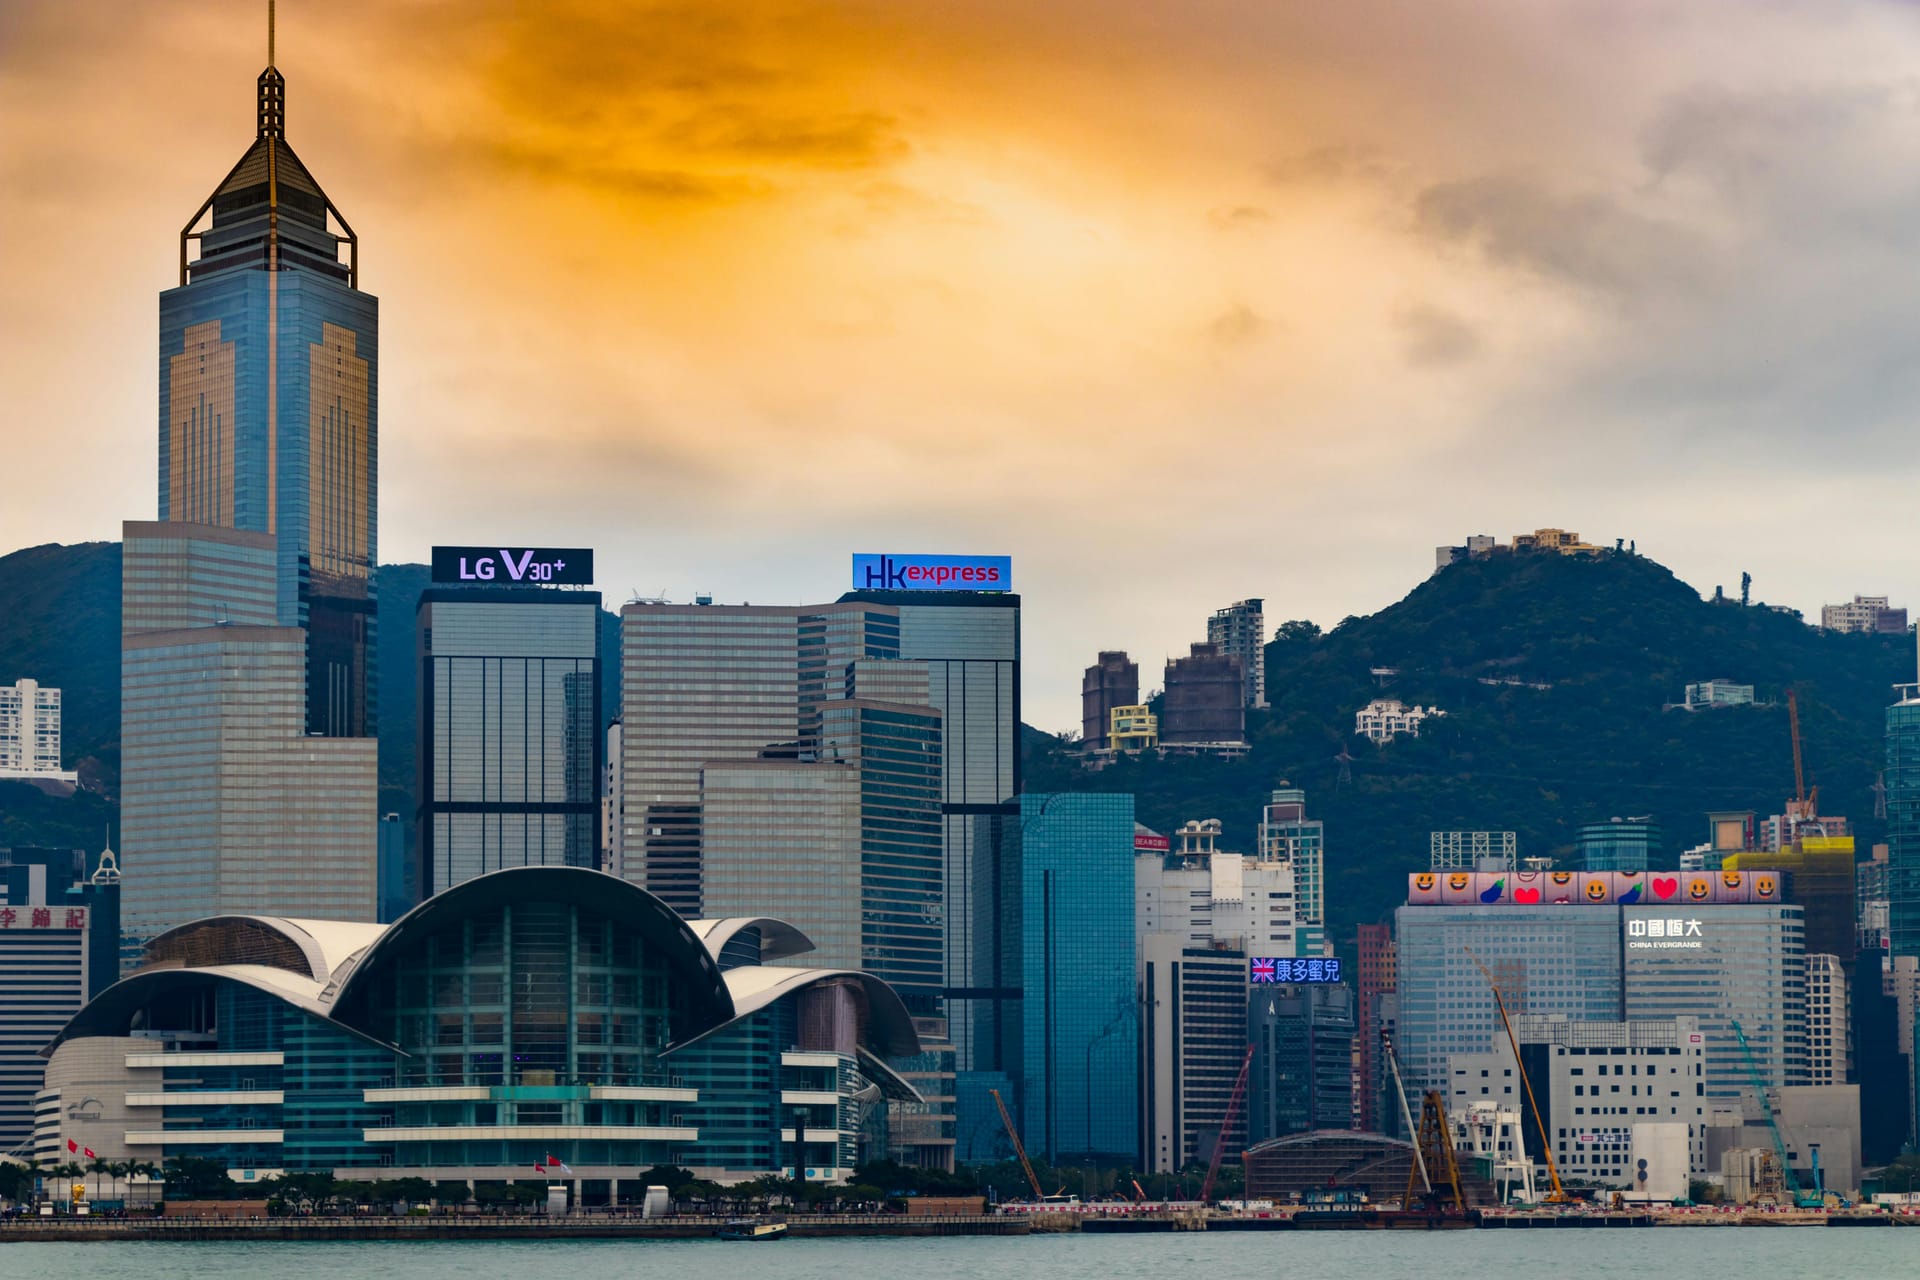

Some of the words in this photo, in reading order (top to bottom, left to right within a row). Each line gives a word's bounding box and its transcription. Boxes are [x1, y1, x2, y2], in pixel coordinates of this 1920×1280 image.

[460, 557, 495, 580] LG
[0, 907, 85, 928] 李錦記
[1629, 941, 1652, 949] CHINA
[1653, 941, 1702, 949] EVERGRANDE
[1276, 959, 1340, 982] 康多蜜兒
